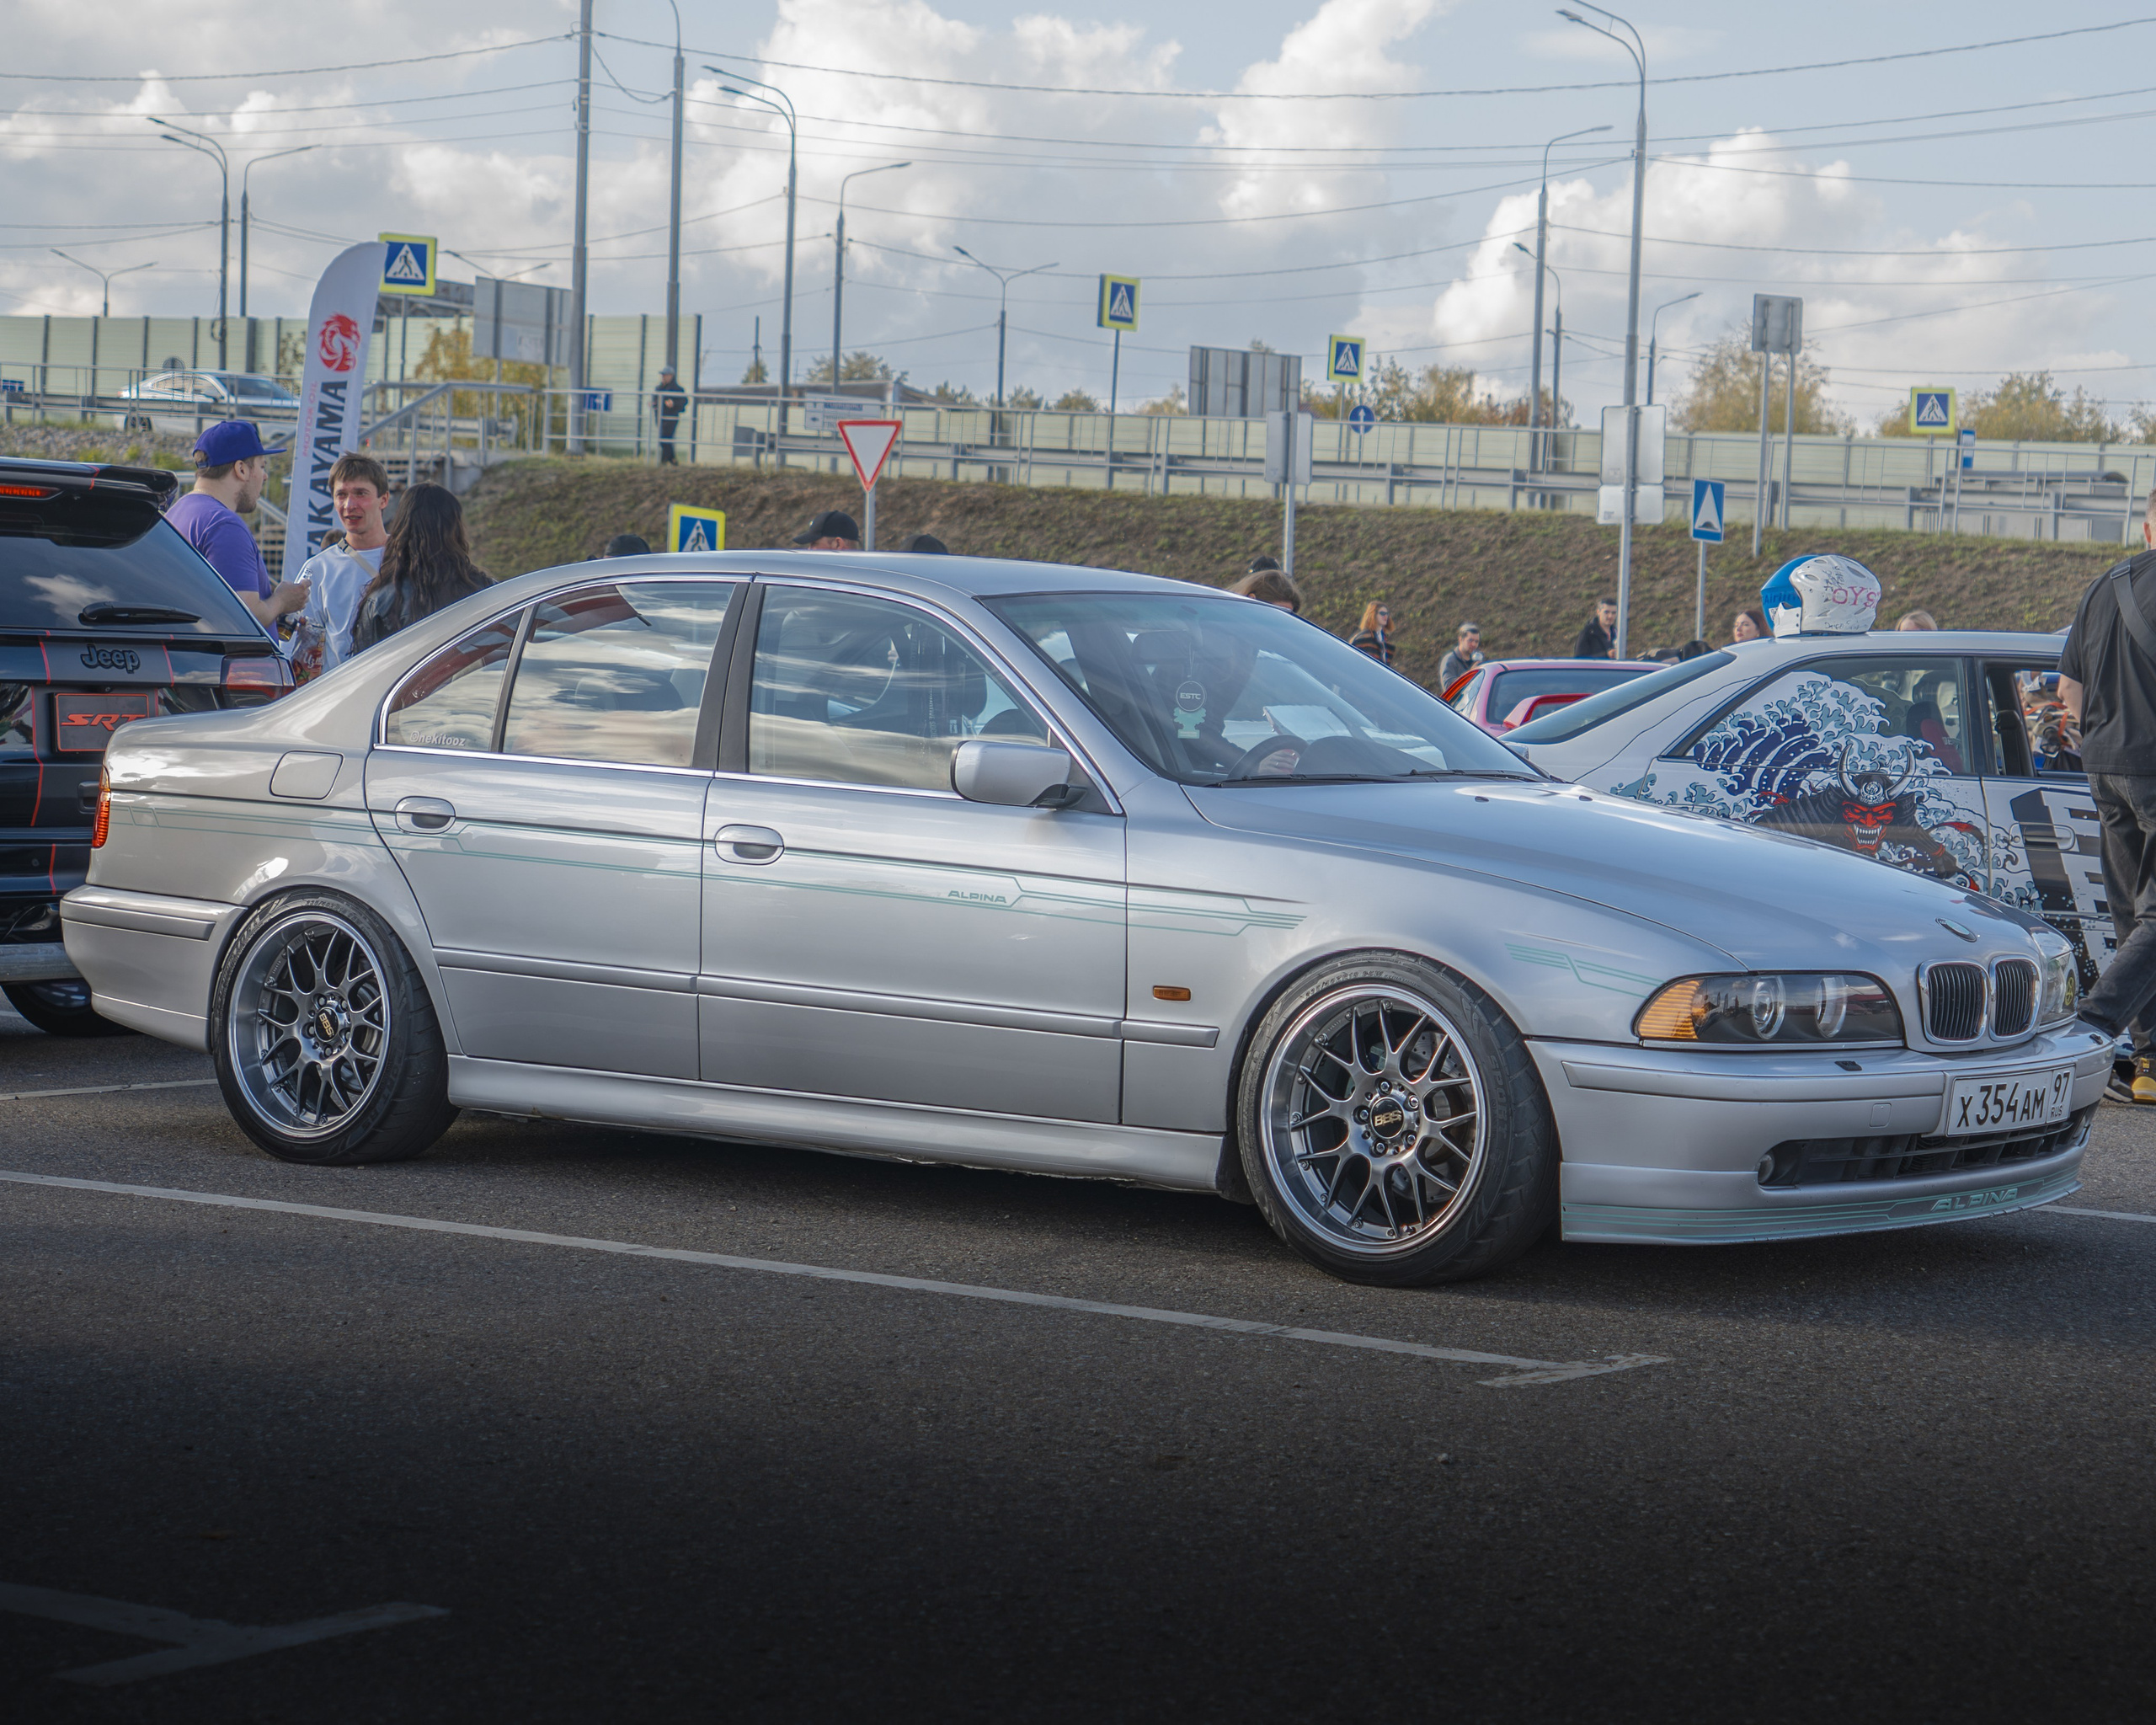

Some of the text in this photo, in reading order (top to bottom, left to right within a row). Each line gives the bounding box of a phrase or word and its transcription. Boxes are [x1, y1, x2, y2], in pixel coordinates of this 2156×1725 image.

[80, 644, 141, 674] Jeep
[61, 713, 146, 731] SRT
[947, 889, 1007, 904] ALPINA
[318, 1012, 334, 1038] BBS
[1488, 1055, 1508, 1139] SPORT
[2053, 1071, 2071, 1104] 97
[1374, 1110, 1402, 1127] BBS
[2050, 1106, 2063, 1119] RUS
[1930, 1188, 2019, 1212] ALPINA
